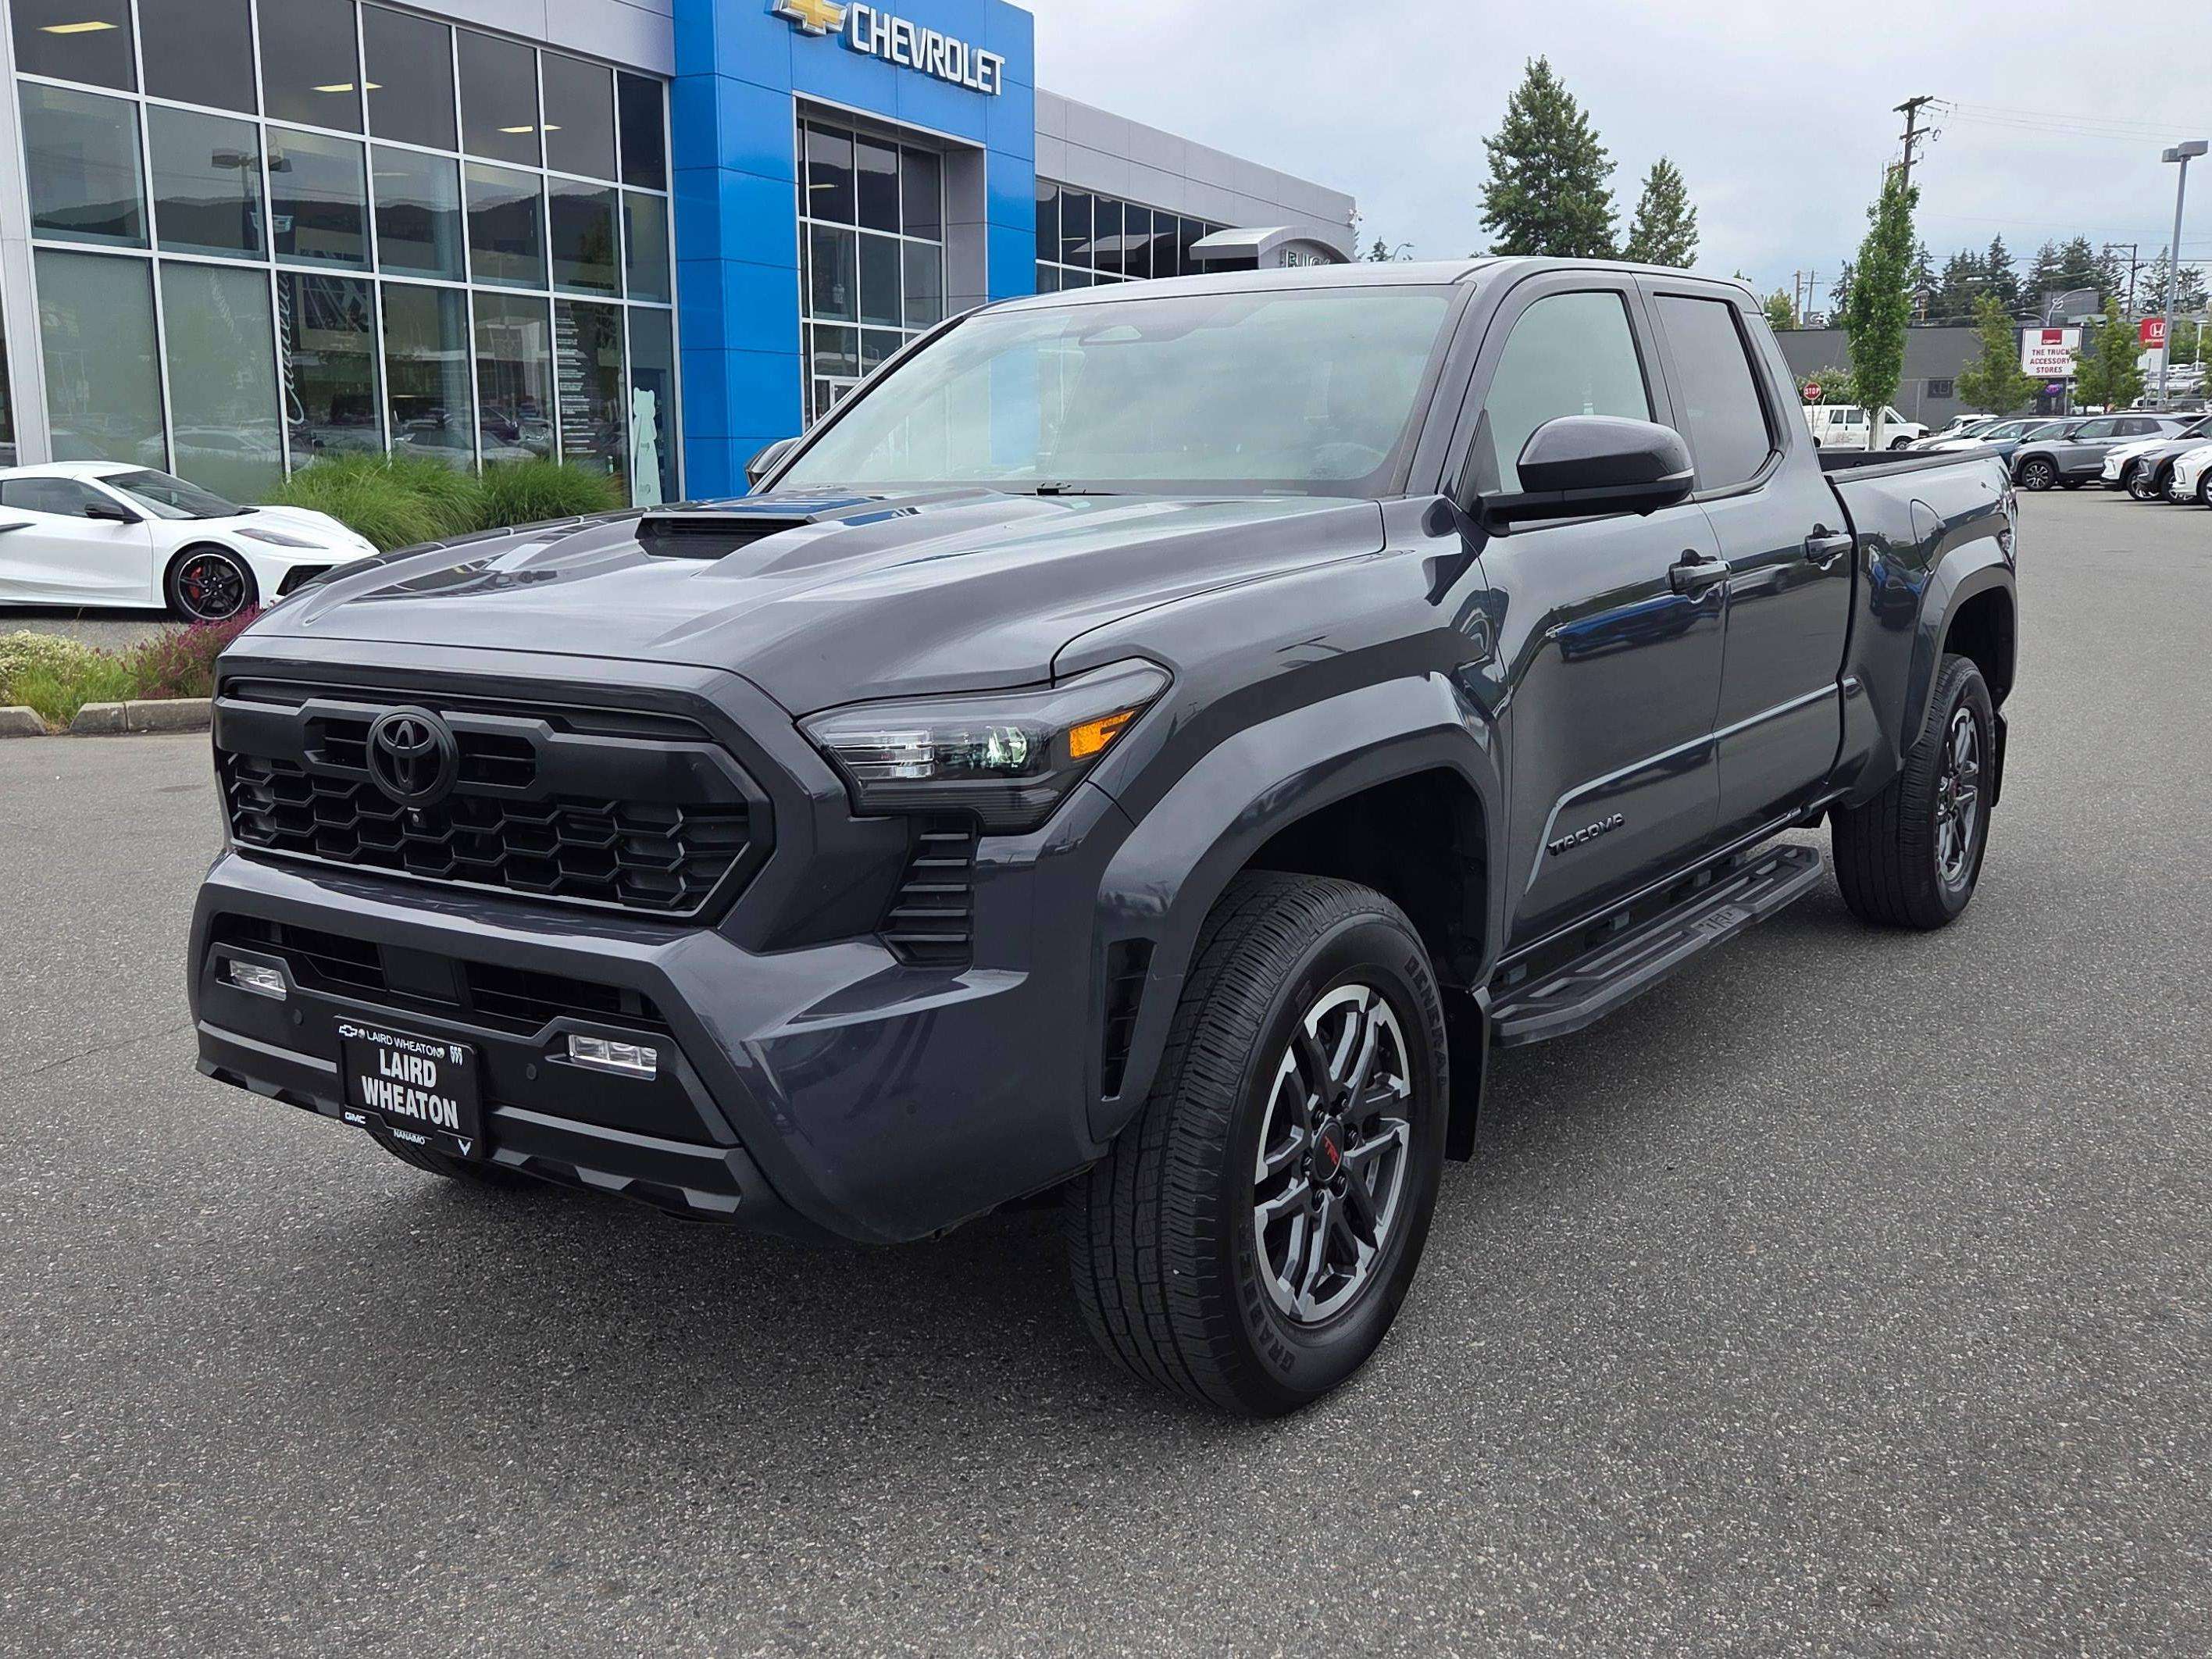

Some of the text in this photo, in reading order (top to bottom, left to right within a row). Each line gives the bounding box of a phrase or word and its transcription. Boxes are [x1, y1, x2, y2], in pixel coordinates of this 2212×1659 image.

[851, 2, 1006, 96] CHEVROLET
[366, 1030, 441, 1058] LAIRD WHEATON
[379, 1048, 437, 1088] LAIRD
[344, 1111, 366, 1124] GMC
[361, 1075, 459, 1129] WHEATON
[394, 1129, 426, 1145] NANAIMO
